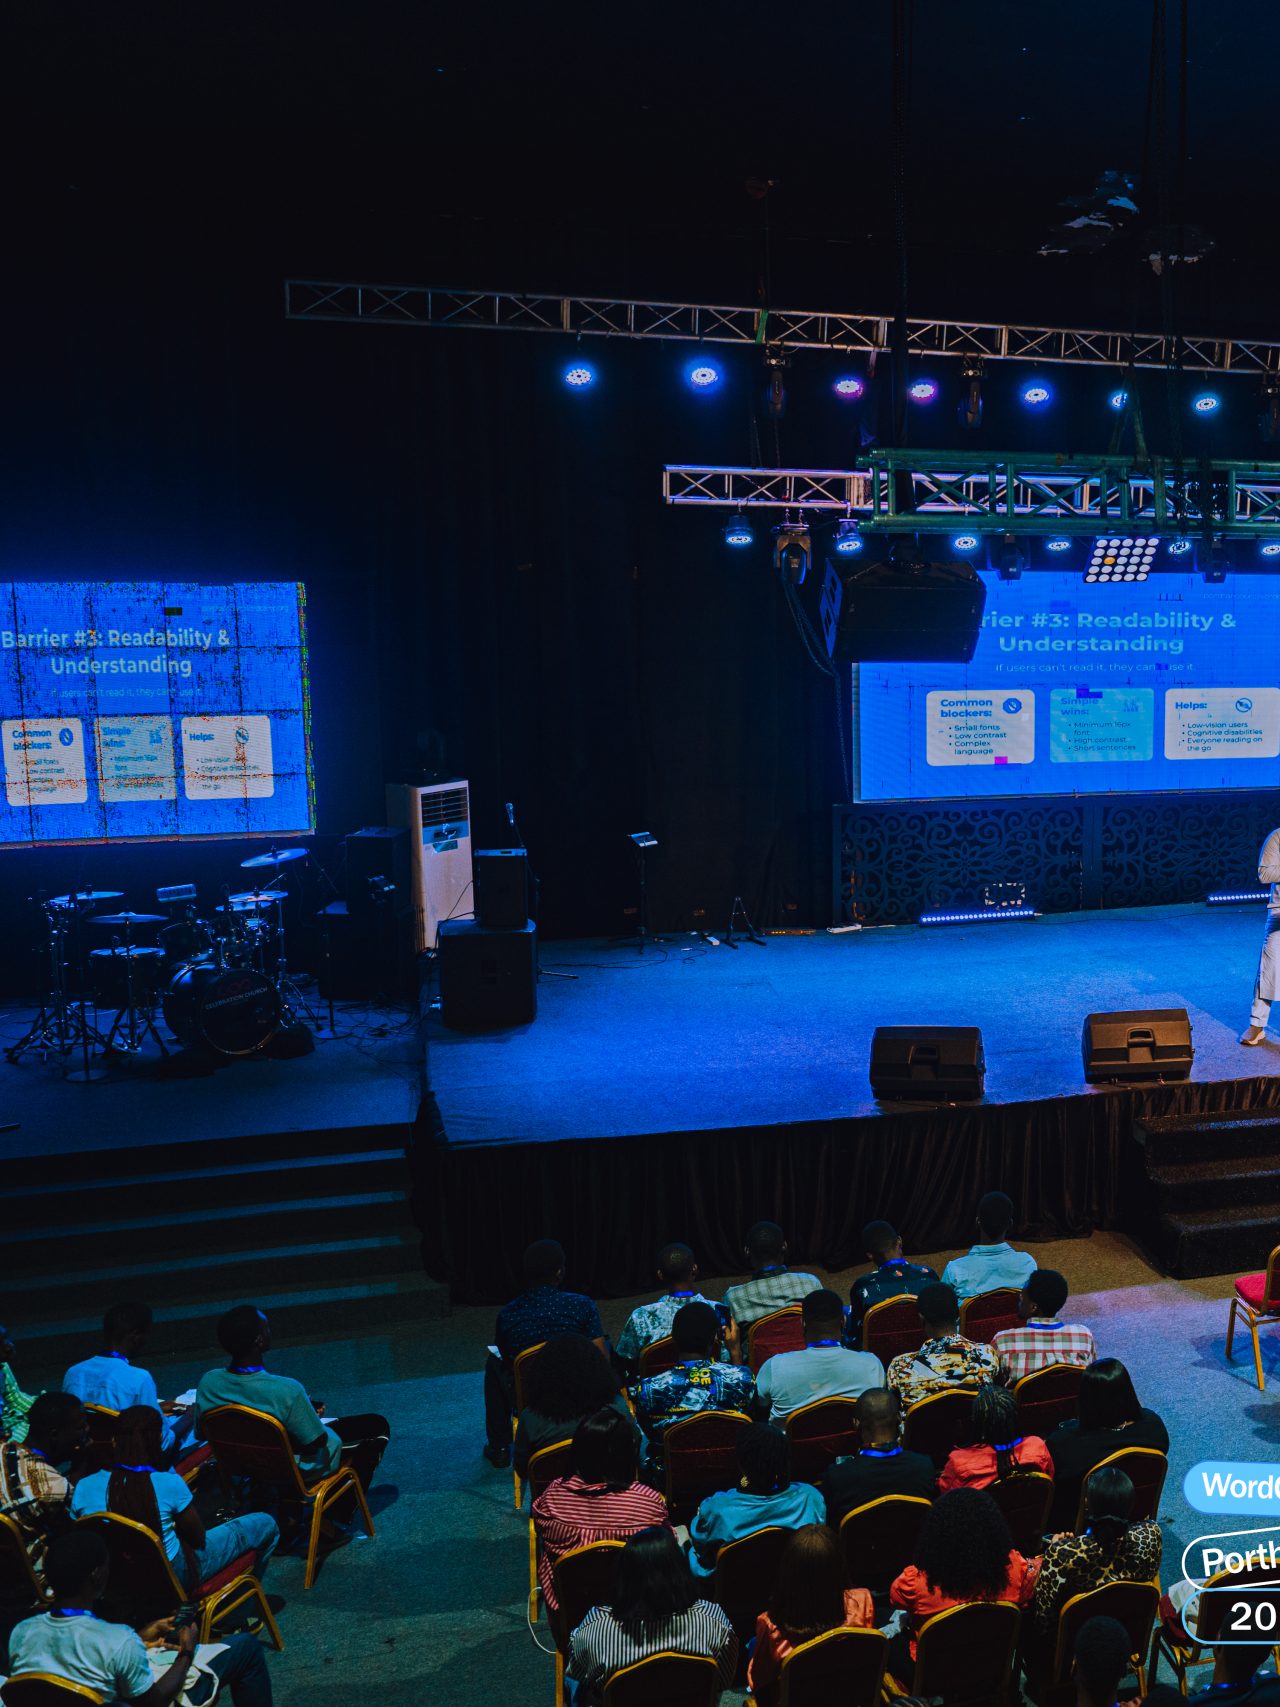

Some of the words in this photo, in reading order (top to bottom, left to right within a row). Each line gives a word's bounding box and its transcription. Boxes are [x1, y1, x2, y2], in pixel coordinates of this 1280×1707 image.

[981, 610, 1024, 628] rier
[1031, 612, 1070, 628] #3:
[1077, 610, 1214, 632] Readability
[1220, 613, 1236, 628] &
[1, 628, 69, 648] Barrier
[108, 628, 212, 650] Readability
[217, 629, 230, 646] &
[999, 634, 1184, 655] Understanding
[51, 654, 193, 677] Understanding
[1006, 664, 1036, 672] users
[1038, 663, 1067, 672] can't
[1069, 663, 1093, 672] read
[1109, 663, 1133, 674] they
[106, 687, 125, 697] read
[136, 686, 155, 699] they
[940, 699, 993, 707] Common
[1060, 697, 1099, 706] Simple
[1175, 701, 1208, 711] Helps:
[940, 709, 993, 718] blockers:
[1060, 707, 1089, 716] wins:
[1187, 721, 1227, 729] Low-vision
[1228, 721, 1249, 729] users
[12, 729, 52, 739] Common
[189, 732, 215, 743] Helps:
[1187, 729, 1222, 738] Cognitive
[1223, 728, 1263, 736] disabilities
[954, 740, 991, 748] Complex
[1094, 736, 1127, 744] contrast
[1187, 737, 1222, 745] Everyone
[1223, 736, 1252, 745] reading
[954, 748, 994, 756] language
[1073, 744, 1094, 752] Short
[1096, 744, 1136, 752] sentences
[1201, 745, 1212, 753] go
